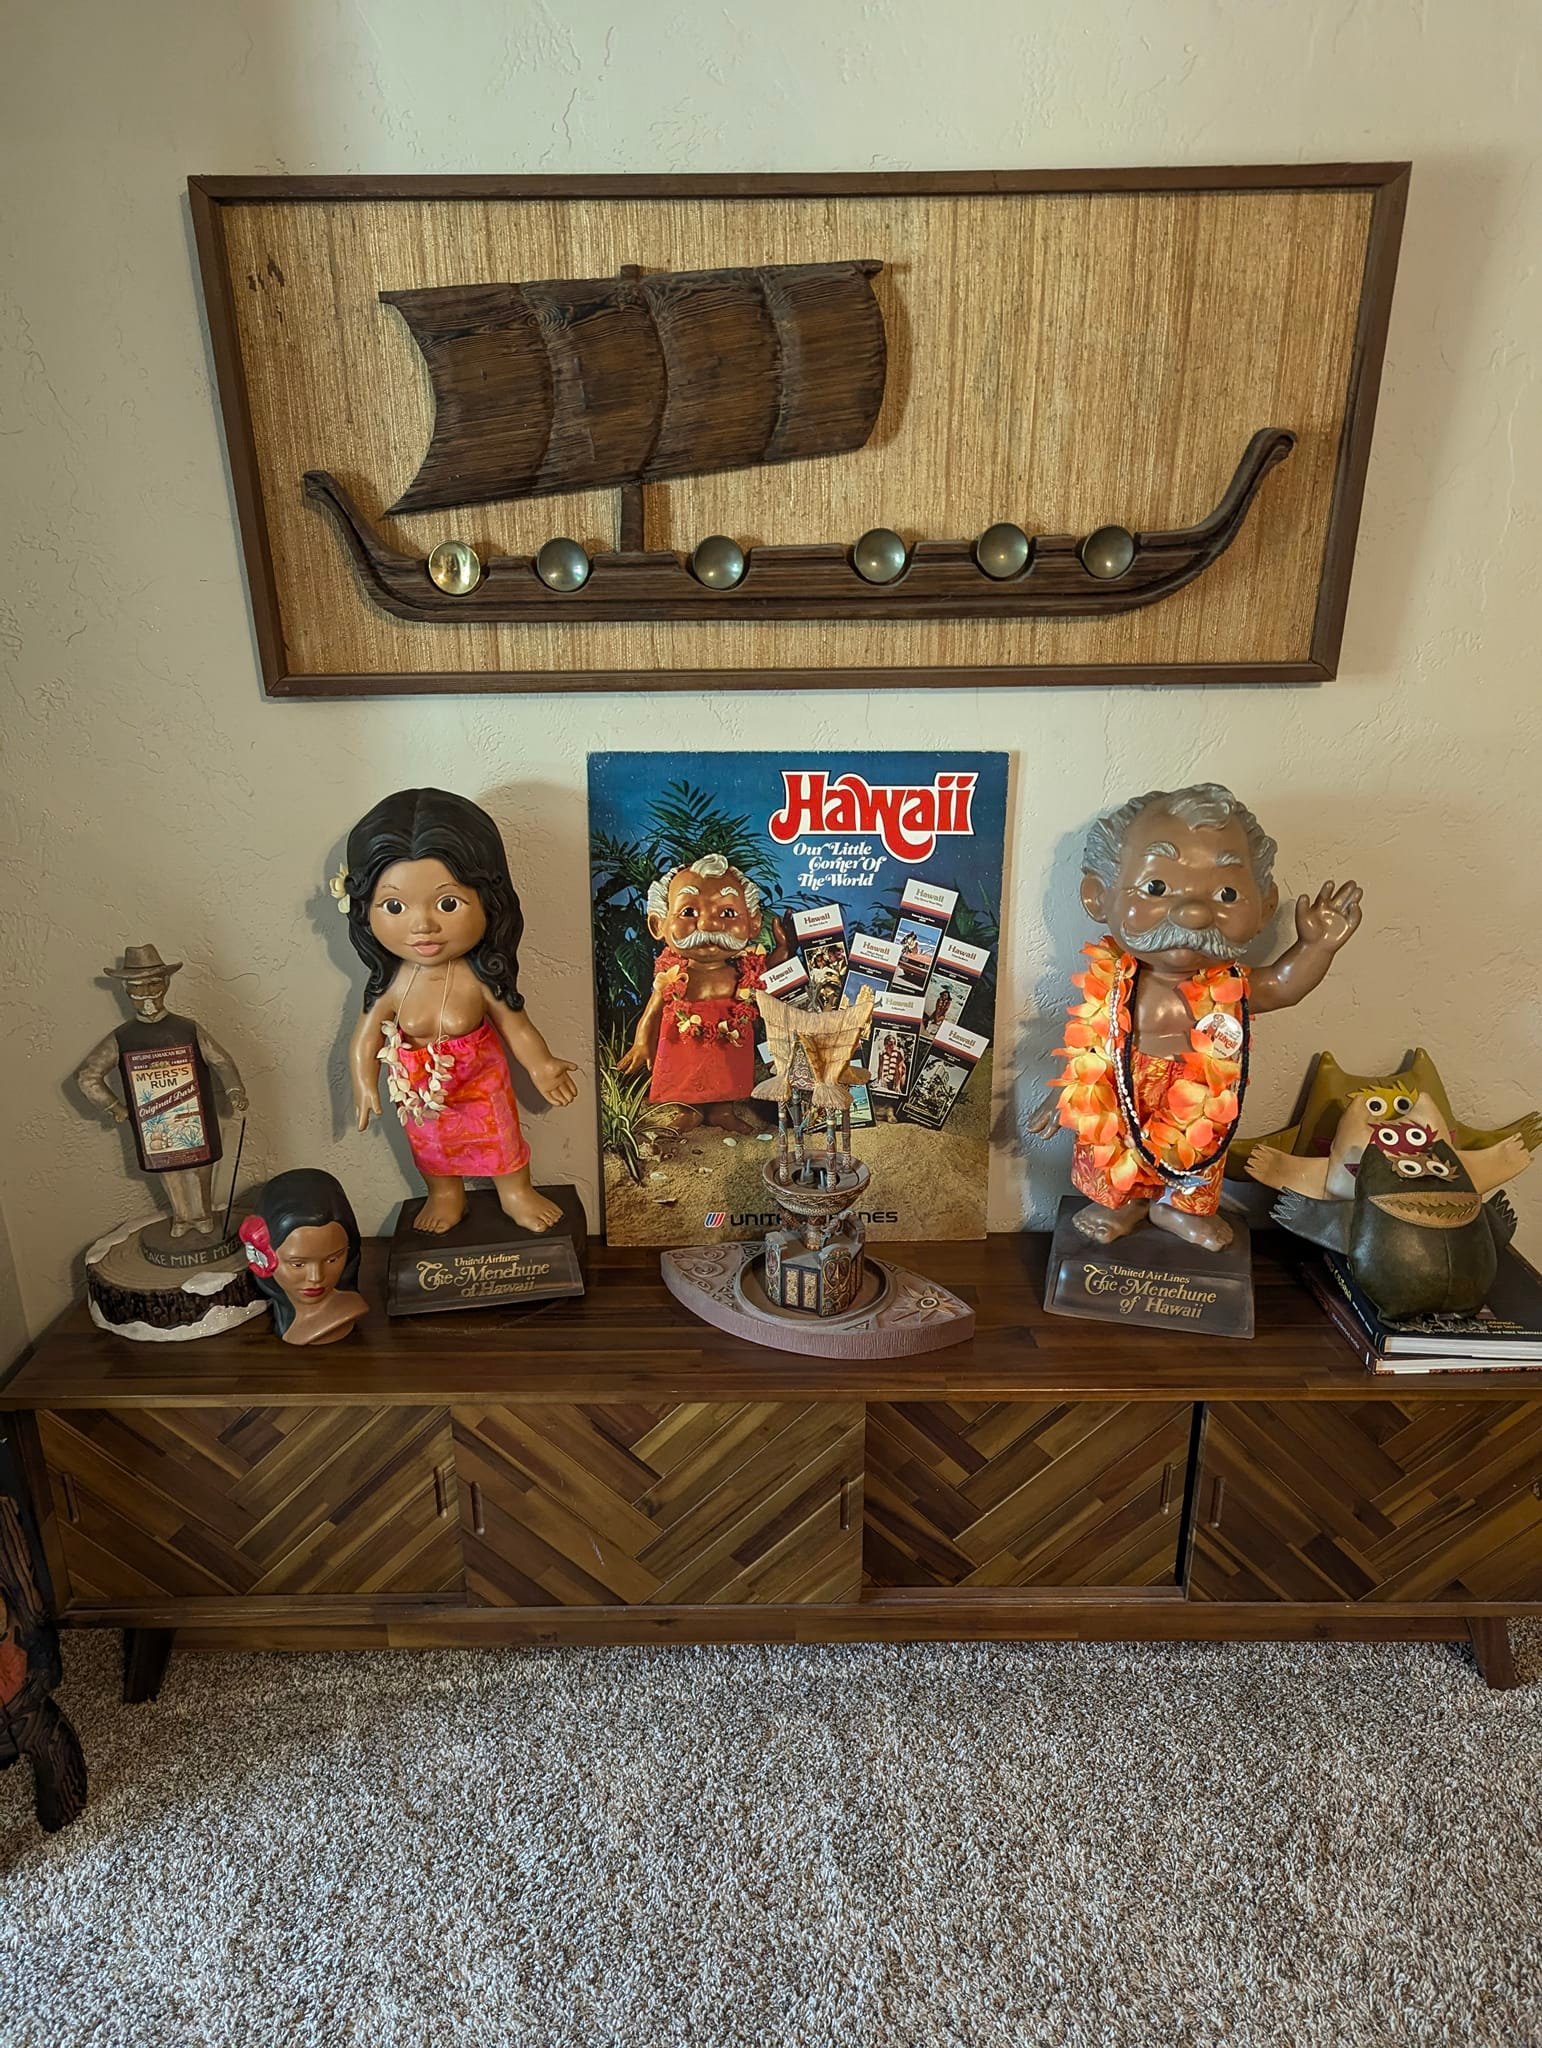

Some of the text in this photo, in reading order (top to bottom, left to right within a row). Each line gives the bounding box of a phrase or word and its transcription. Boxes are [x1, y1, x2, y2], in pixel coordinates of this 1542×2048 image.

[769, 772, 976, 862] Hawaii
[792, 842, 872, 856] Our Little
[808, 856, 887, 874] Corner Of
[797, 872, 875, 891] The World
[136, 1066, 190, 1082] MYERS'S
[150, 1078, 178, 1090] RUM
[139, 1084, 196, 1118] Original Dark
[170, 1251, 208, 1266] MINE
[454, 1255, 485, 1268] United
[416, 1260, 550, 1292] The Menehune
[1109, 1265, 1146, 1279] United
[461, 1277, 536, 1298] of Hawaii
[1083, 1264, 1217, 1304] The Menehune
[1119, 1295, 1204, 1319] of Hawaii
